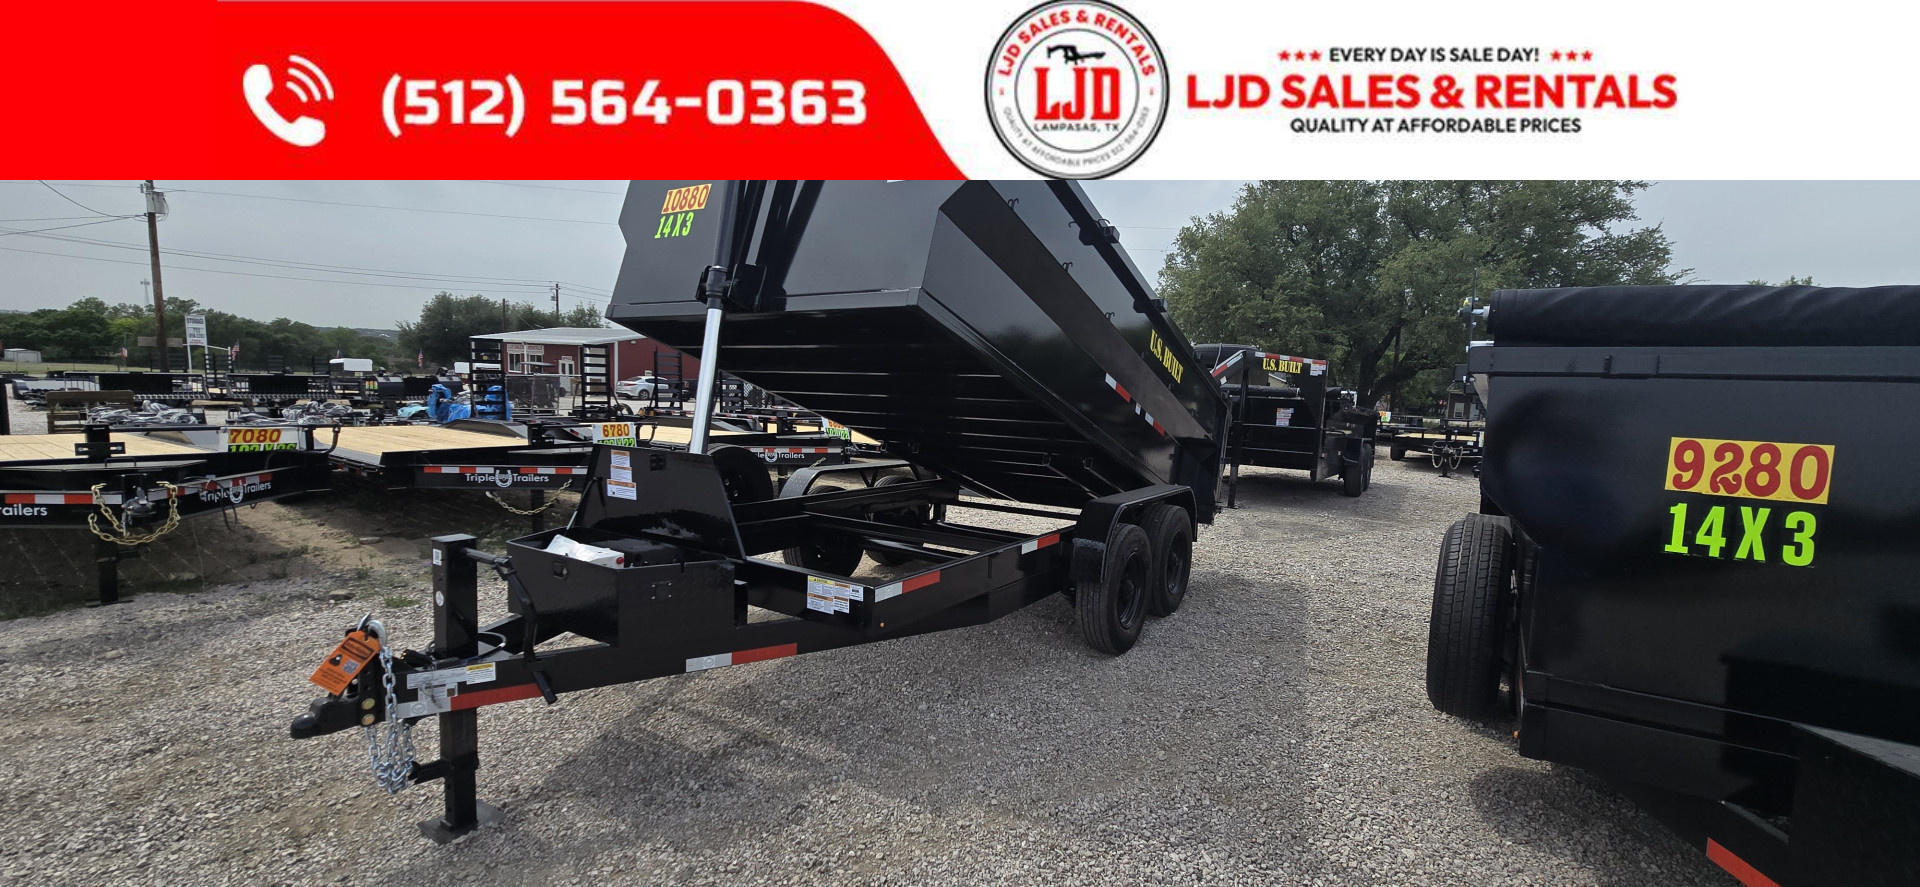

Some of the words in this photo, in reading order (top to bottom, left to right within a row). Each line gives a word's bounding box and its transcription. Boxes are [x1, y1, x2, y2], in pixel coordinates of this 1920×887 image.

[663, 184, 709, 213] 10880
[1163, 346, 1184, 384] BUILT
[1263, 358, 1277, 371] U.S.
[1278, 359, 1303, 374] BUILT
[230, 429, 282, 443] 7080
[602, 423, 630, 438] 6780
[1672, 439, 1829, 500] 9280
[465, 473, 496, 484] Triple
[513, 473, 549, 482] Trailers
[244, 482, 272, 494] Trailers
